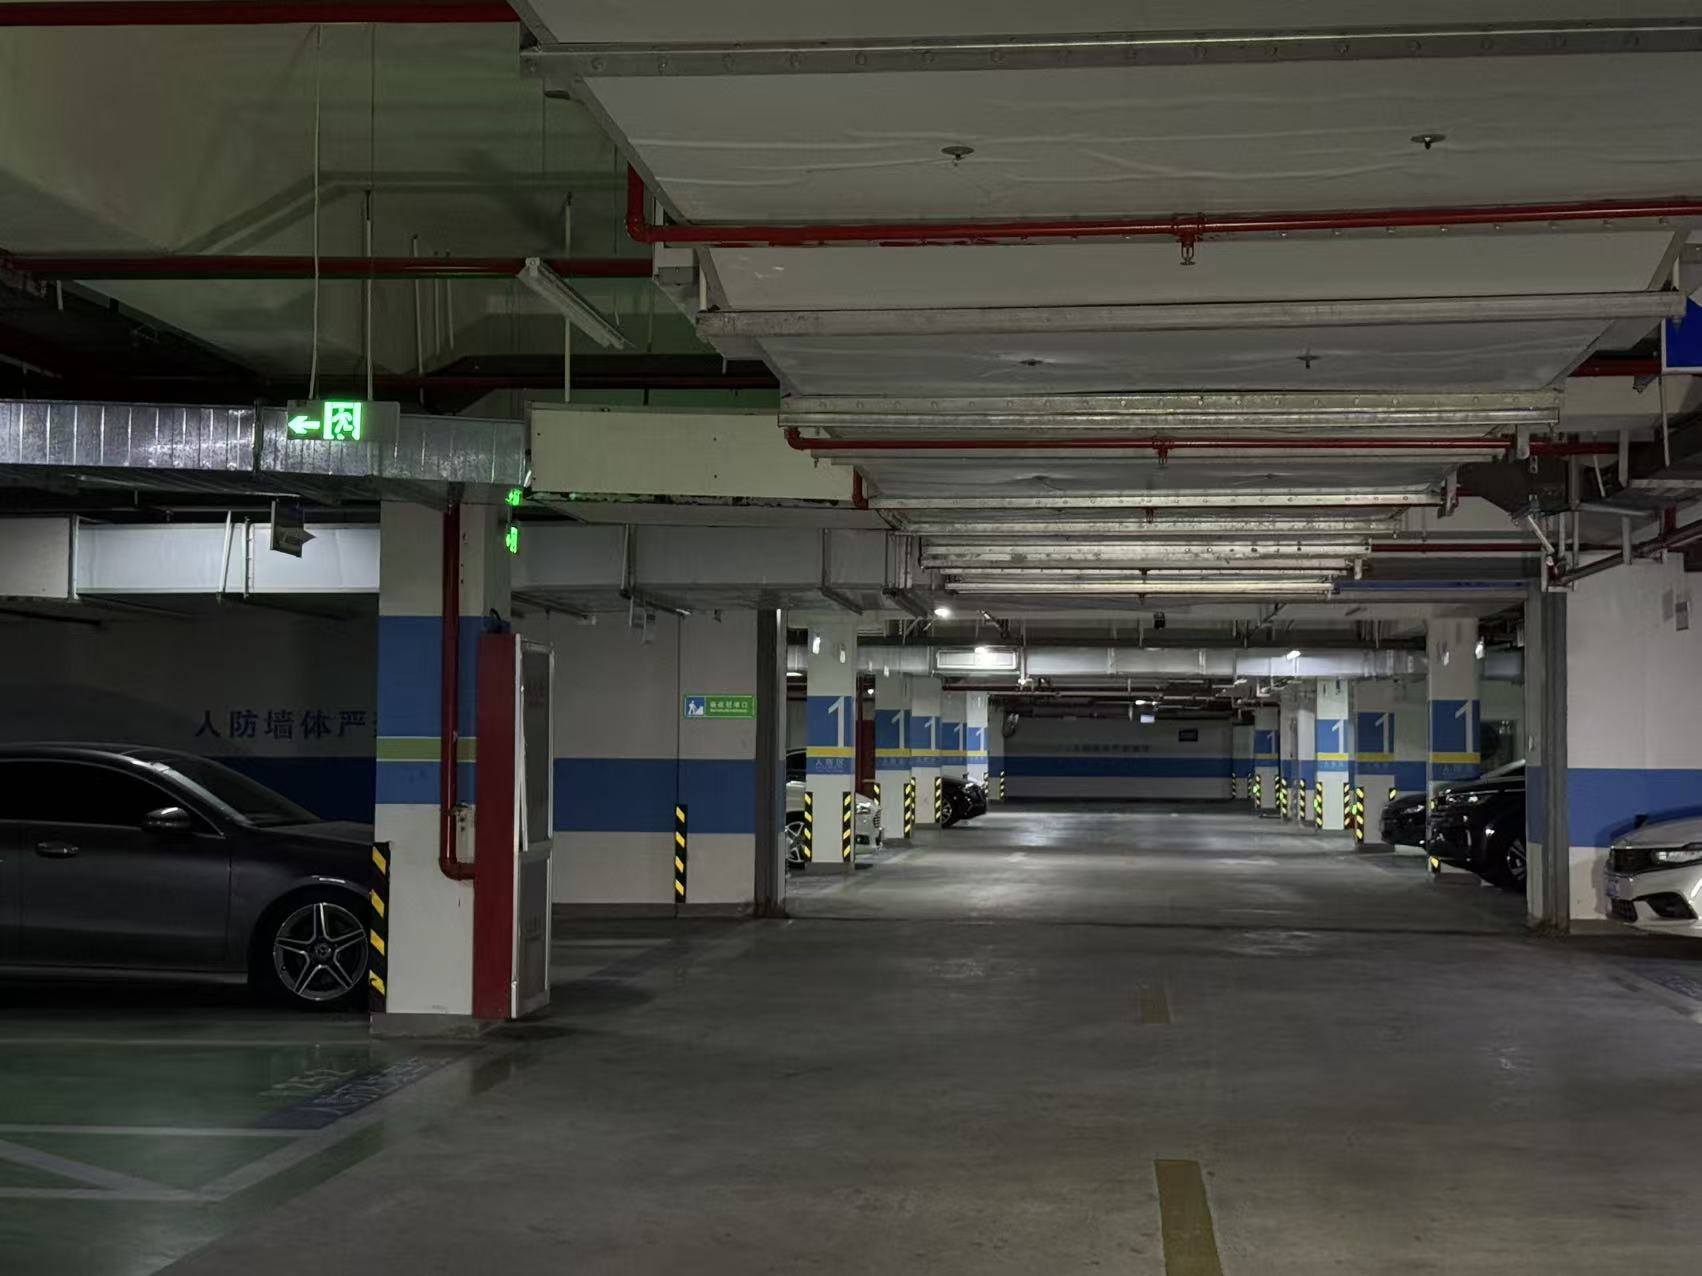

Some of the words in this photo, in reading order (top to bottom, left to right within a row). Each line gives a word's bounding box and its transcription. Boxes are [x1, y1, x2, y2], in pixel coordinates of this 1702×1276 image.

[195, 709, 377, 740] 人防墙体严
[827, 695, 845, 748] 1
[891, 709, 905, 749] 1
[924, 715, 936, 750] 1
[1331, 720, 1344, 753] 1
[1375, 712, 1390, 753] 1
[1455, 699, 1473, 753] 1
